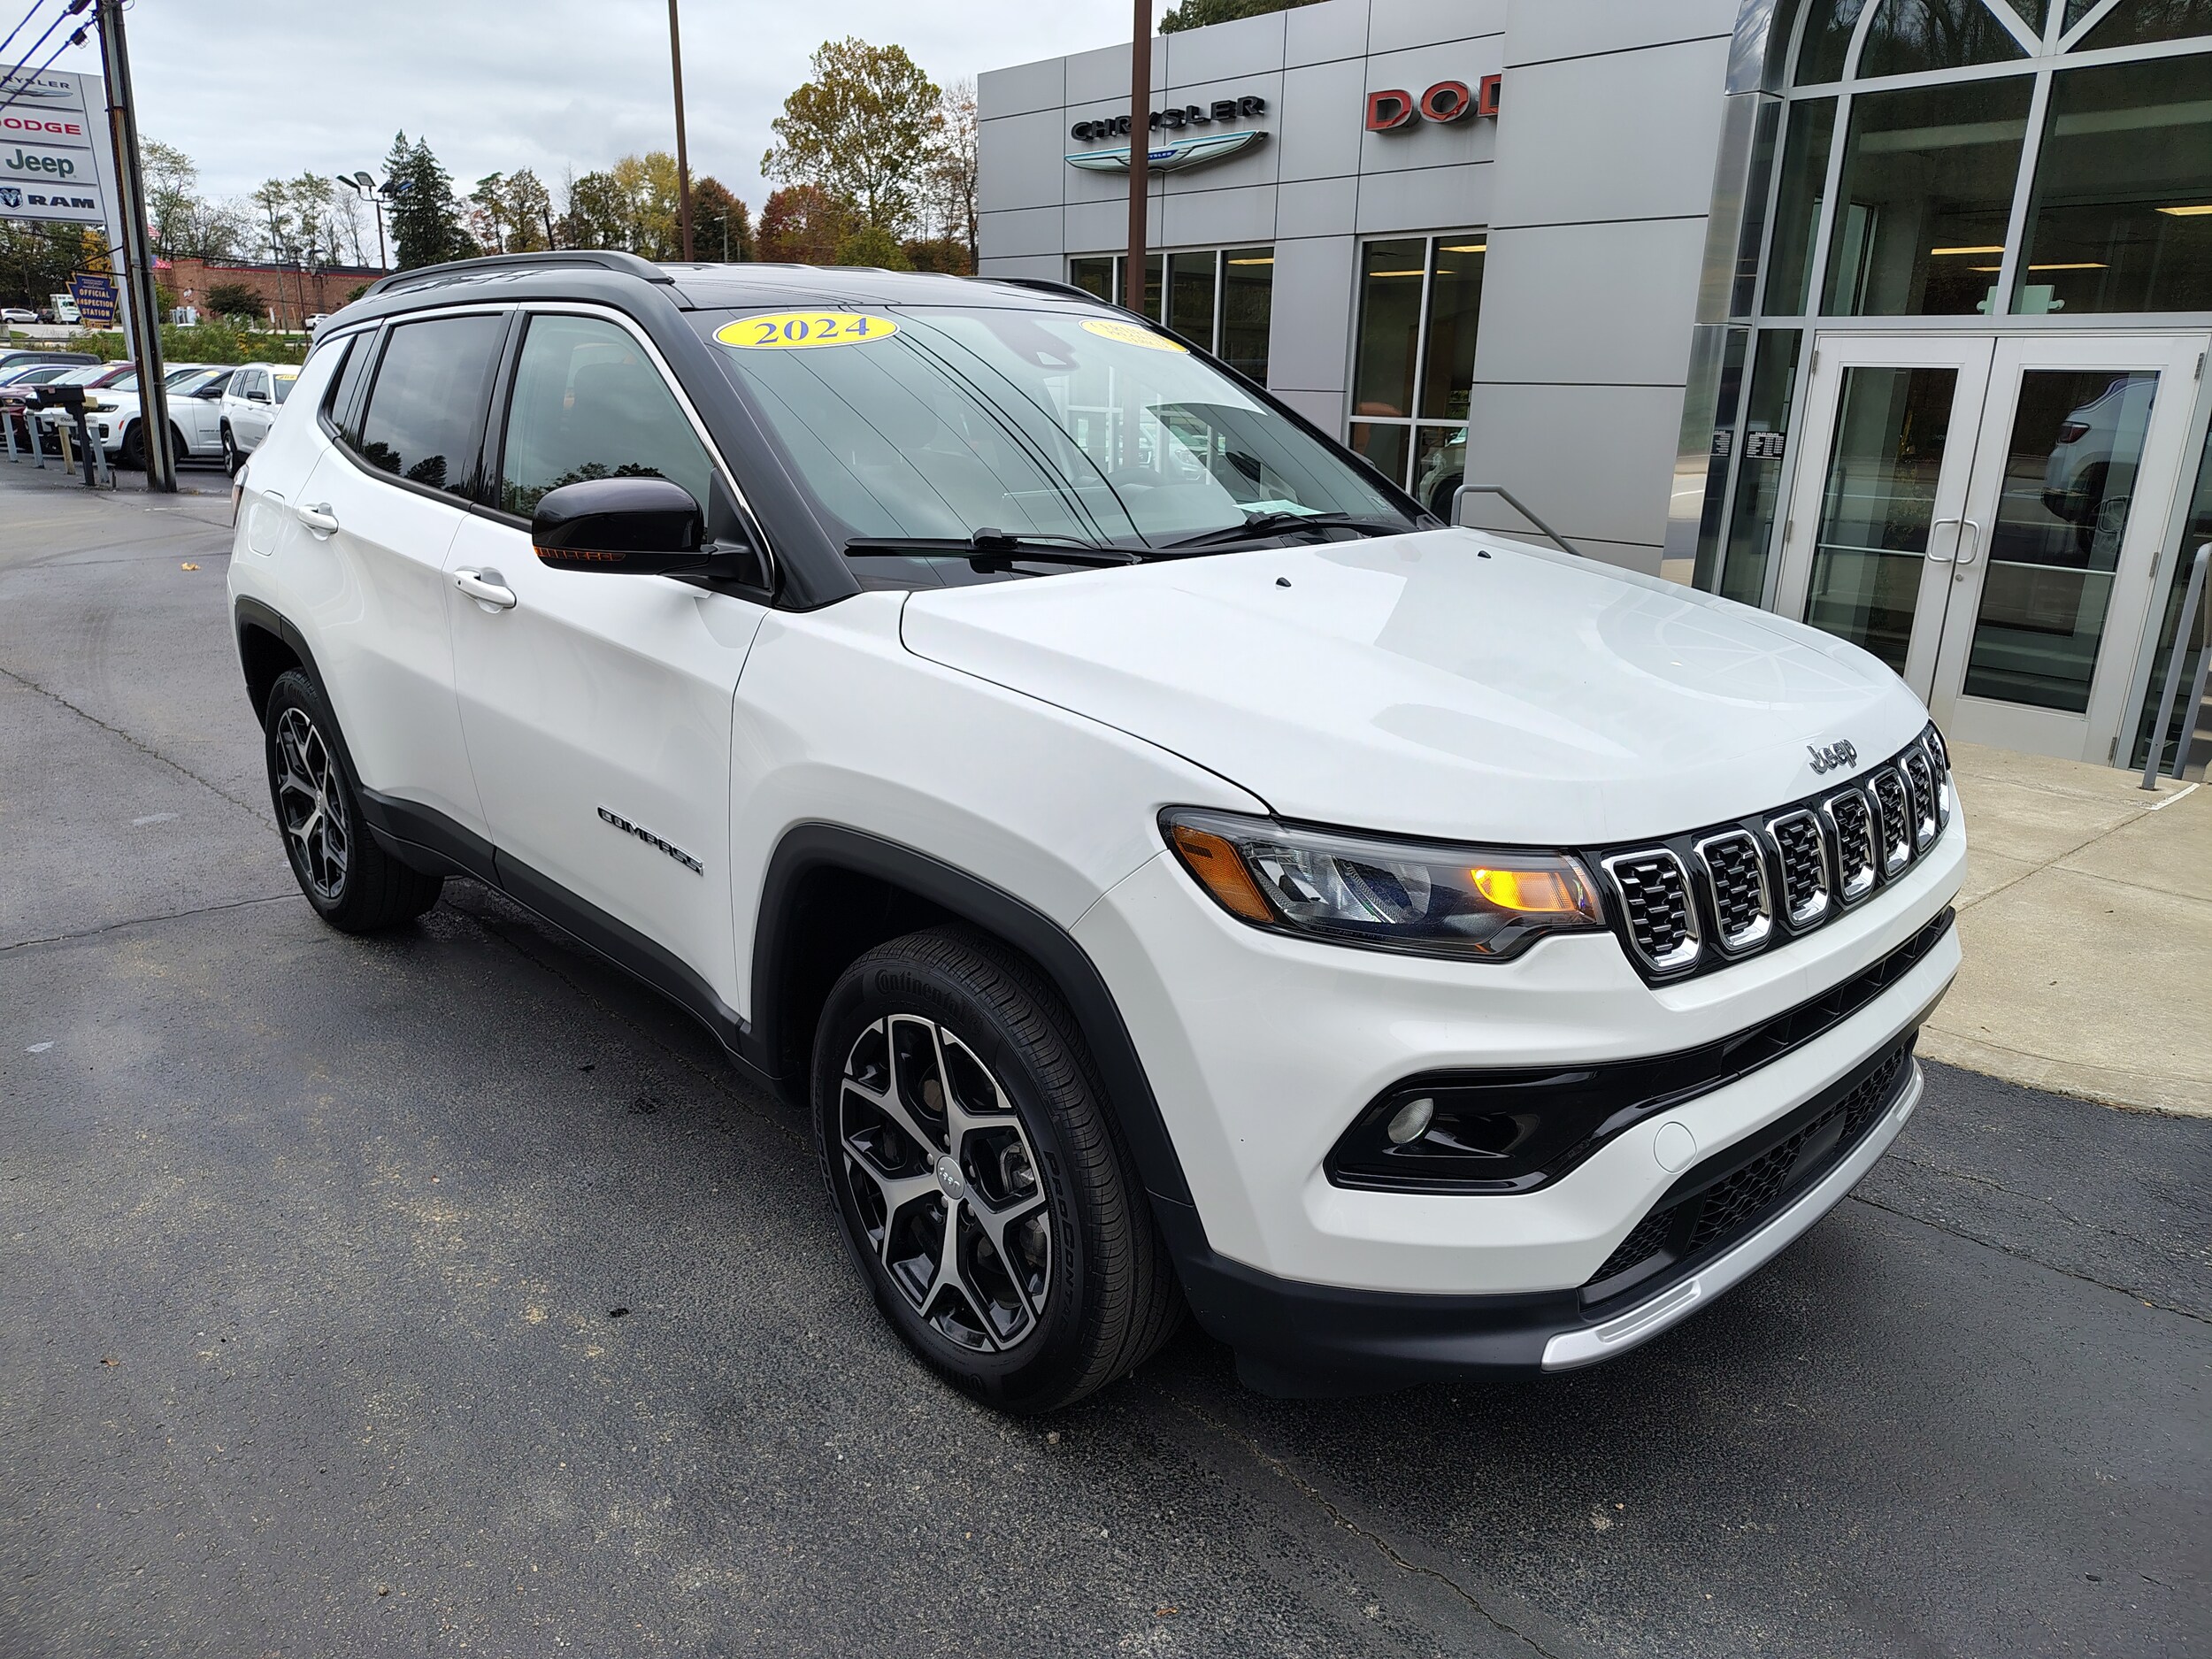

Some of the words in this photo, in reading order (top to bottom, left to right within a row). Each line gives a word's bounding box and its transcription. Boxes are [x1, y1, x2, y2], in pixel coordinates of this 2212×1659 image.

[0, 75, 71, 89] RYSLER
[0, 118, 81, 135] ODGE
[5, 148, 74, 178] Jeep
[27, 194, 96, 209] RAM
[76, 297, 114, 308] INSPECTION
[79, 288, 110, 299] OFFICIAL
[81, 308, 111, 318] STATION
[754, 317, 870, 345] 2024
[1807, 739, 1857, 775] Jeep
[597, 806, 704, 877] COMPASS
[875, 969, 967, 1020] Continental
[939, 1167, 961, 1191] Jeep
